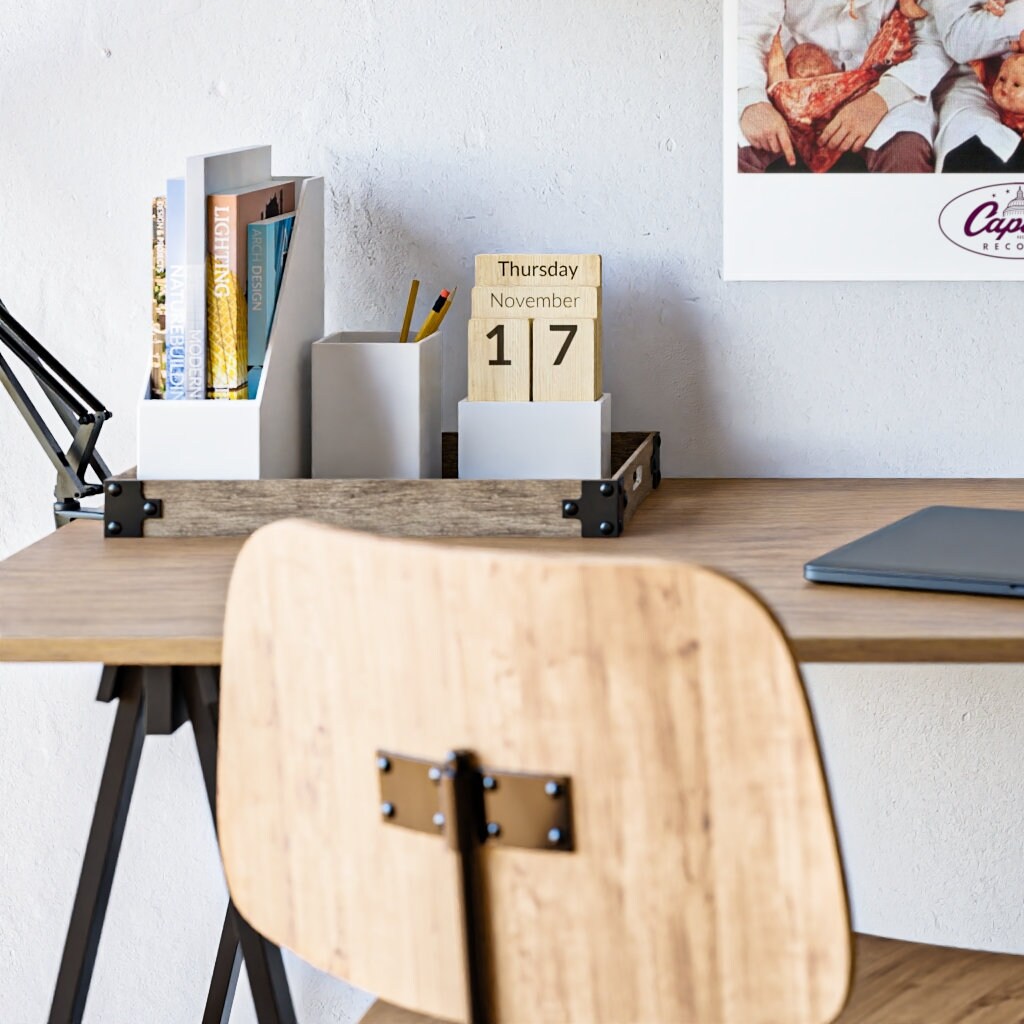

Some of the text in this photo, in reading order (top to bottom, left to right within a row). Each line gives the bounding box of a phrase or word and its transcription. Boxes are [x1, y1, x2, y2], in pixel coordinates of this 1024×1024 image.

[213, 206, 230, 297] LIGHTING
[252, 229, 262, 311] ARCH DESIGN
[498, 260, 579, 280] Thursday
[490, 292, 580, 308] November
[188, 329, 202, 399] MODERN
